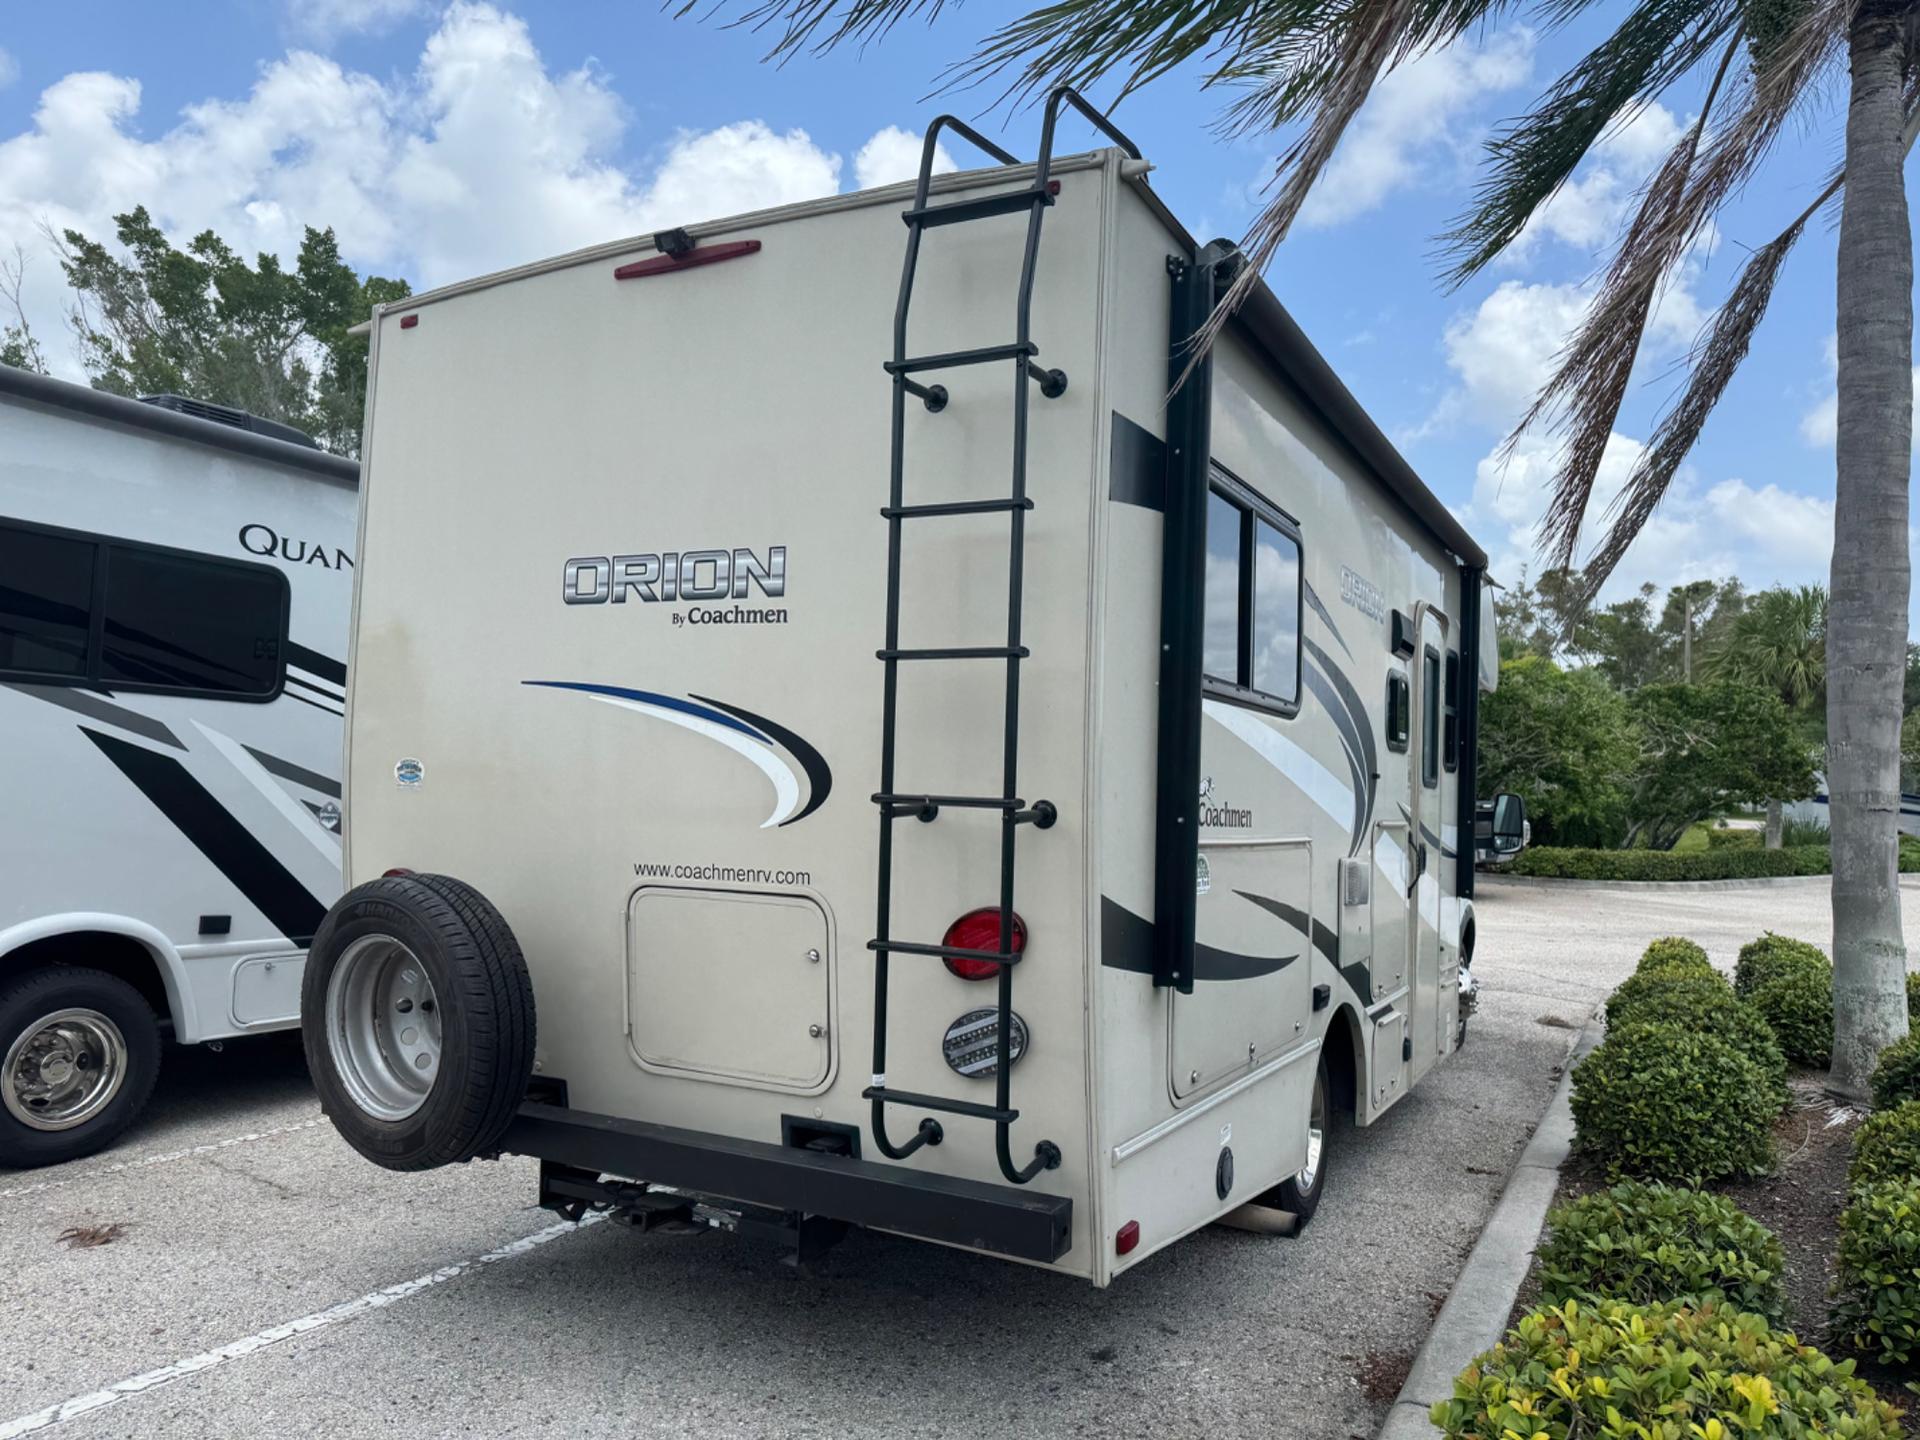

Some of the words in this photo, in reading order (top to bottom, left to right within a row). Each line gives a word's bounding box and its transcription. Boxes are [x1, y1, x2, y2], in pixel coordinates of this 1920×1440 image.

[563, 546, 787, 605] ORION
[672, 612, 687, 628] By
[687, 605, 788, 625] Coachmen
[1198, 801, 1253, 828] Coachmen
[633, 863, 811, 885] www.coachmenrv.com
